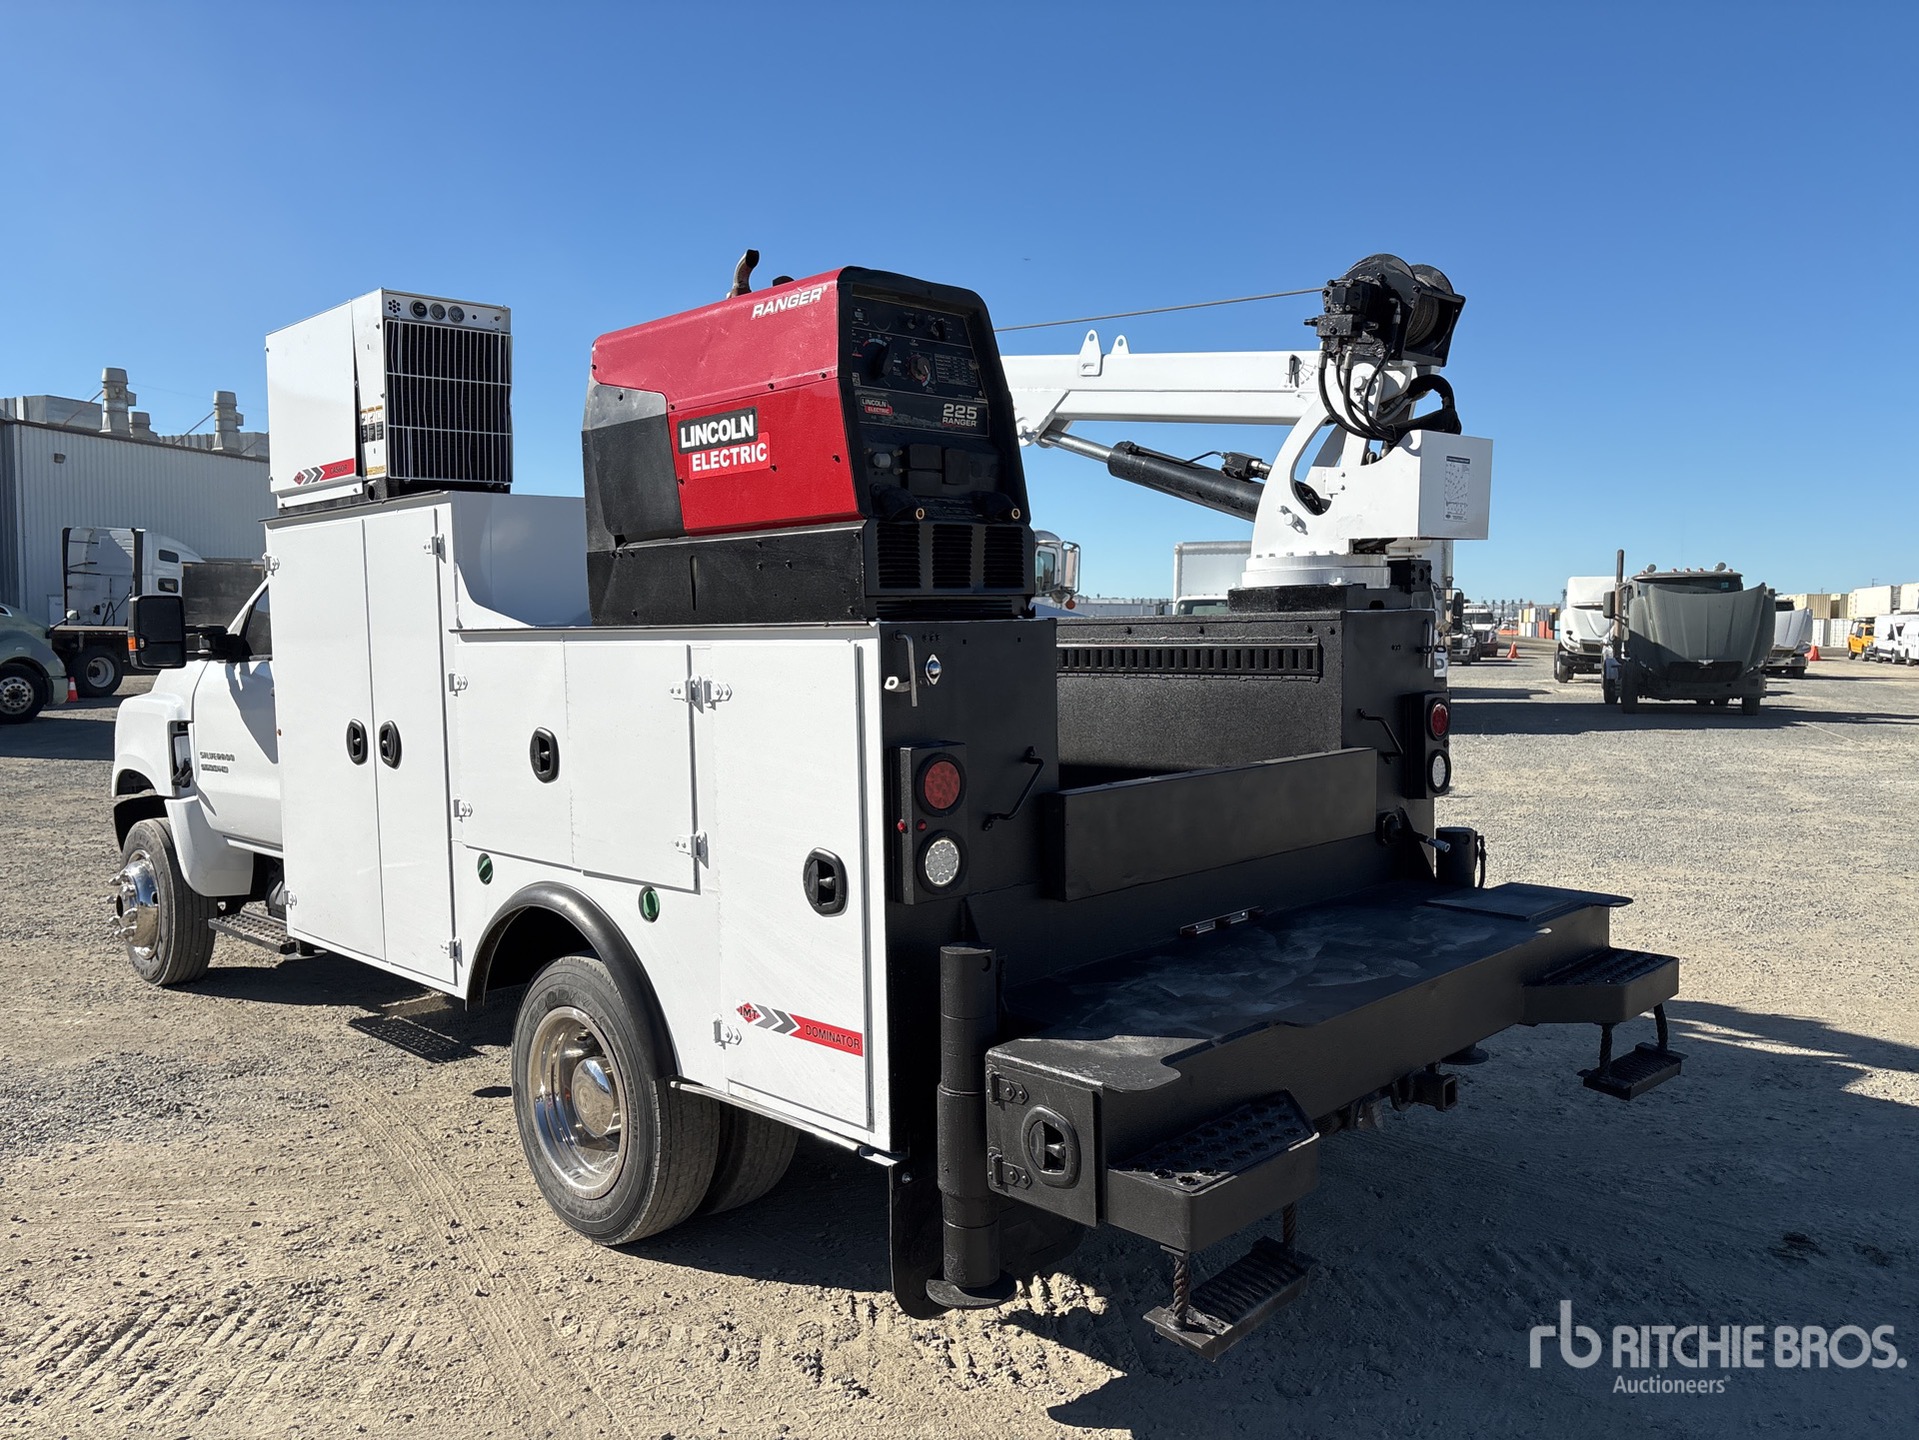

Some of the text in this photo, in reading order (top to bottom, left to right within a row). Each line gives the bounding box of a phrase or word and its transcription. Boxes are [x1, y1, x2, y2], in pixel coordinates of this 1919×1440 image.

[751, 287, 823, 319] RANGER
[862, 398, 887, 408] LINCOLN
[943, 403, 978, 419] 225
[680, 414, 755, 449] LINCOLN
[942, 417, 977, 427] RANGER
[692, 442, 767, 472] ELECTRIC
[739, 1005, 757, 1020] IMT
[805, 1024, 860, 1050] DOMINATOR
